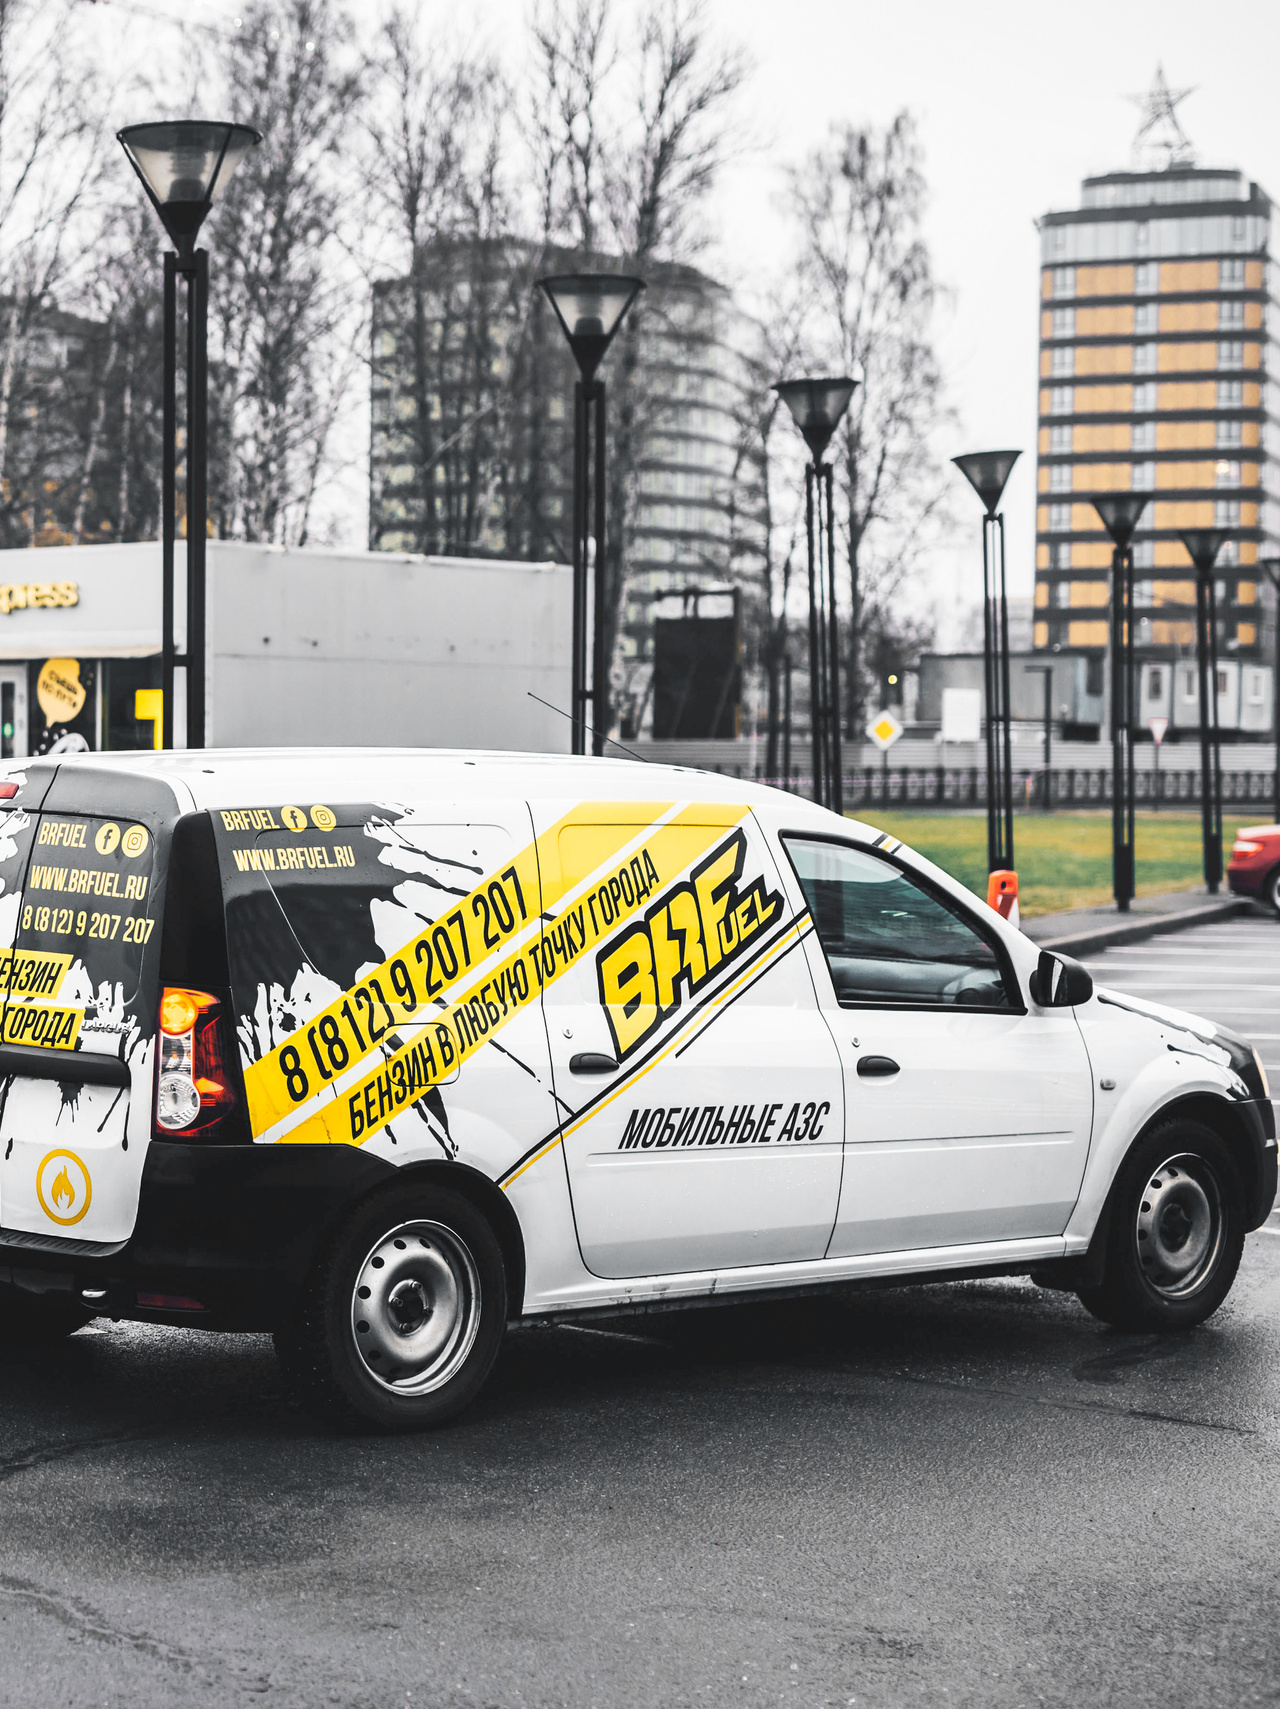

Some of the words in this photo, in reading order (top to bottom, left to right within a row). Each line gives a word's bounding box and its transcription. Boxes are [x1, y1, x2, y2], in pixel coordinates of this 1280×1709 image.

[37, 821, 88, 849] BRFUEL
[219, 809, 281, 832] BRFUEL
[232, 845, 357, 872] WWW.BRFUEL.RU
[29, 864, 149, 901] WWW.BRFUEL.RU
[21, 904, 34, 930] 8
[33, 906, 75, 935] (812)
[75, 910, 88, 936] 9
[88, 912, 122, 941] 207
[122, 916, 156, 945] 207
[278, 1044, 310, 1103] 8
[306, 977, 397, 1081] (812)
[389, 958, 418, 1013] 9
[414, 909, 472, 998] 207
[471, 865, 528, 950] 207
[348, 1035, 438, 1141] БЕНЗИН
[434, 1023, 456, 1069] В
[452, 958, 530, 1055] ЛЮБУЮ
[528, 903, 587, 987] ТОЧКУ
[586, 847, 660, 937] ГОРОДА
[617, 1103, 784, 1150] МОБИЛЬНЫЕ
[776, 1101, 831, 1143] АЗС
